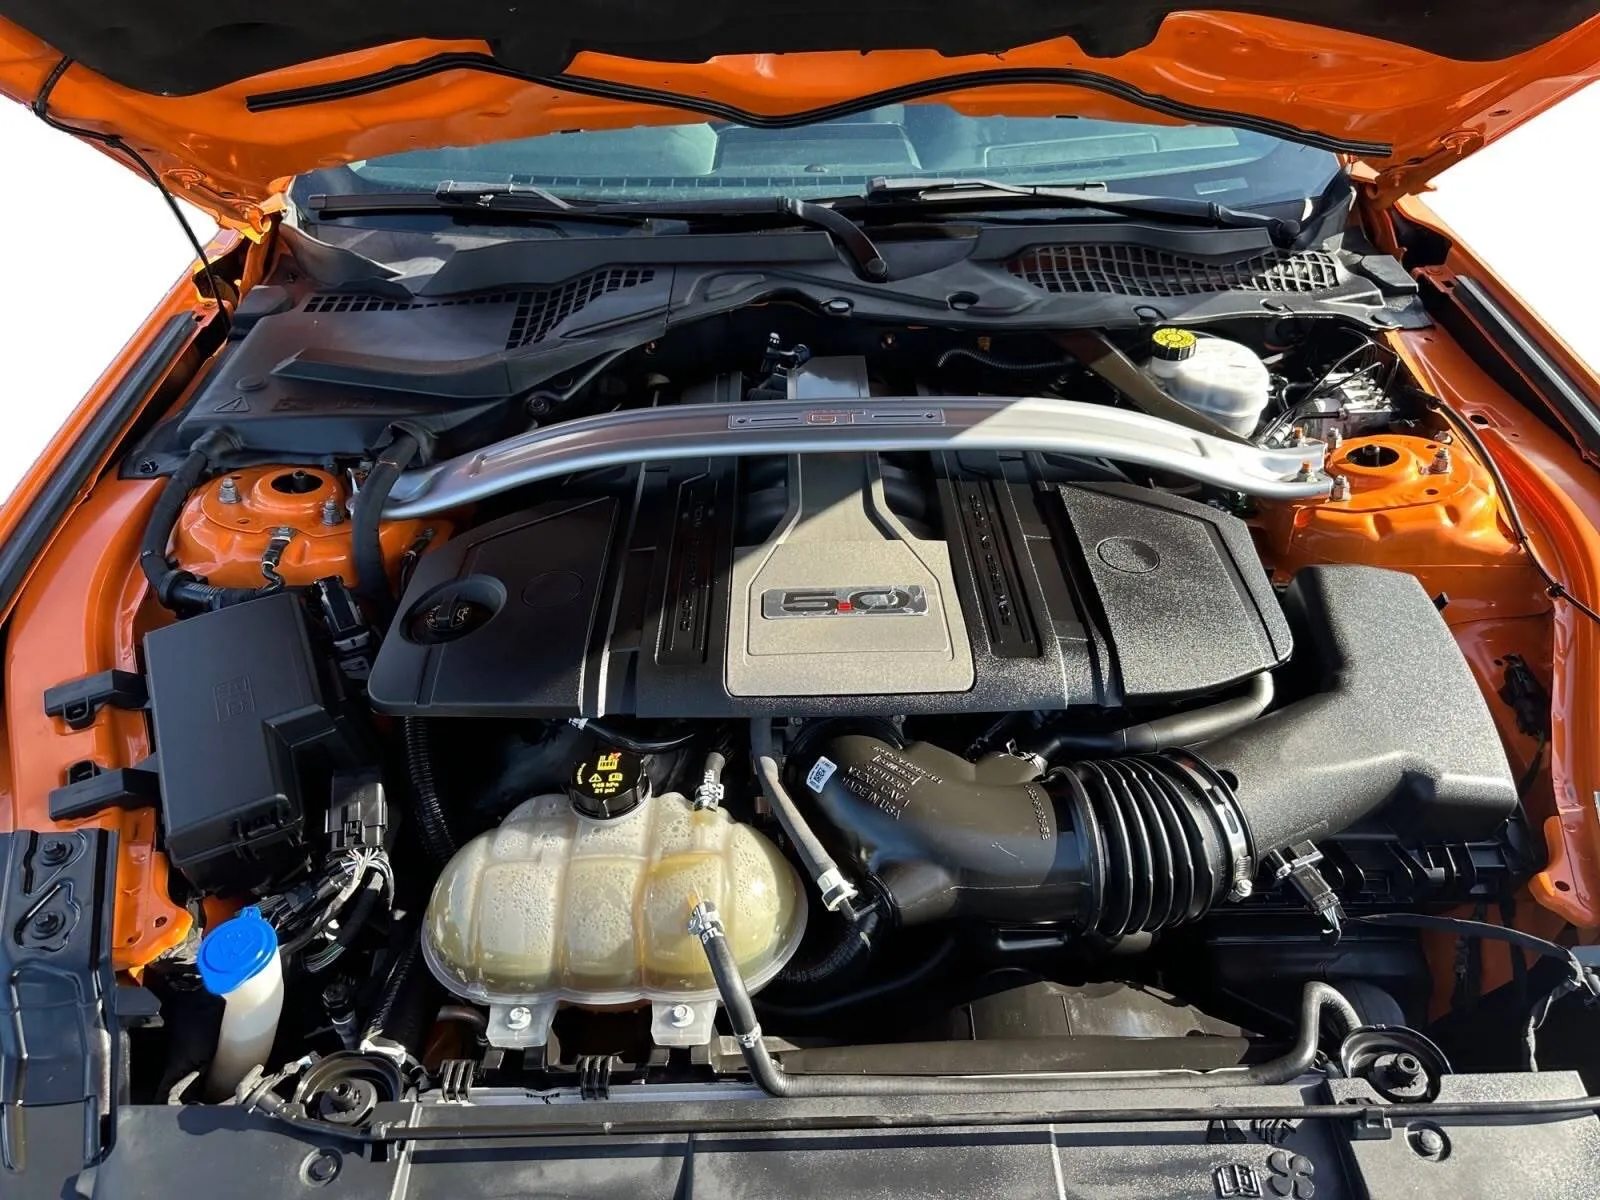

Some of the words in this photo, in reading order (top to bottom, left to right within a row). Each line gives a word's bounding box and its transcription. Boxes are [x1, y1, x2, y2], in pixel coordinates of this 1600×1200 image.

[807, 409, 866, 425] GT
[781, 590, 912, 613] 5.0
[841, 777, 868, 797] MADE
[879, 799, 901, 820] USA
